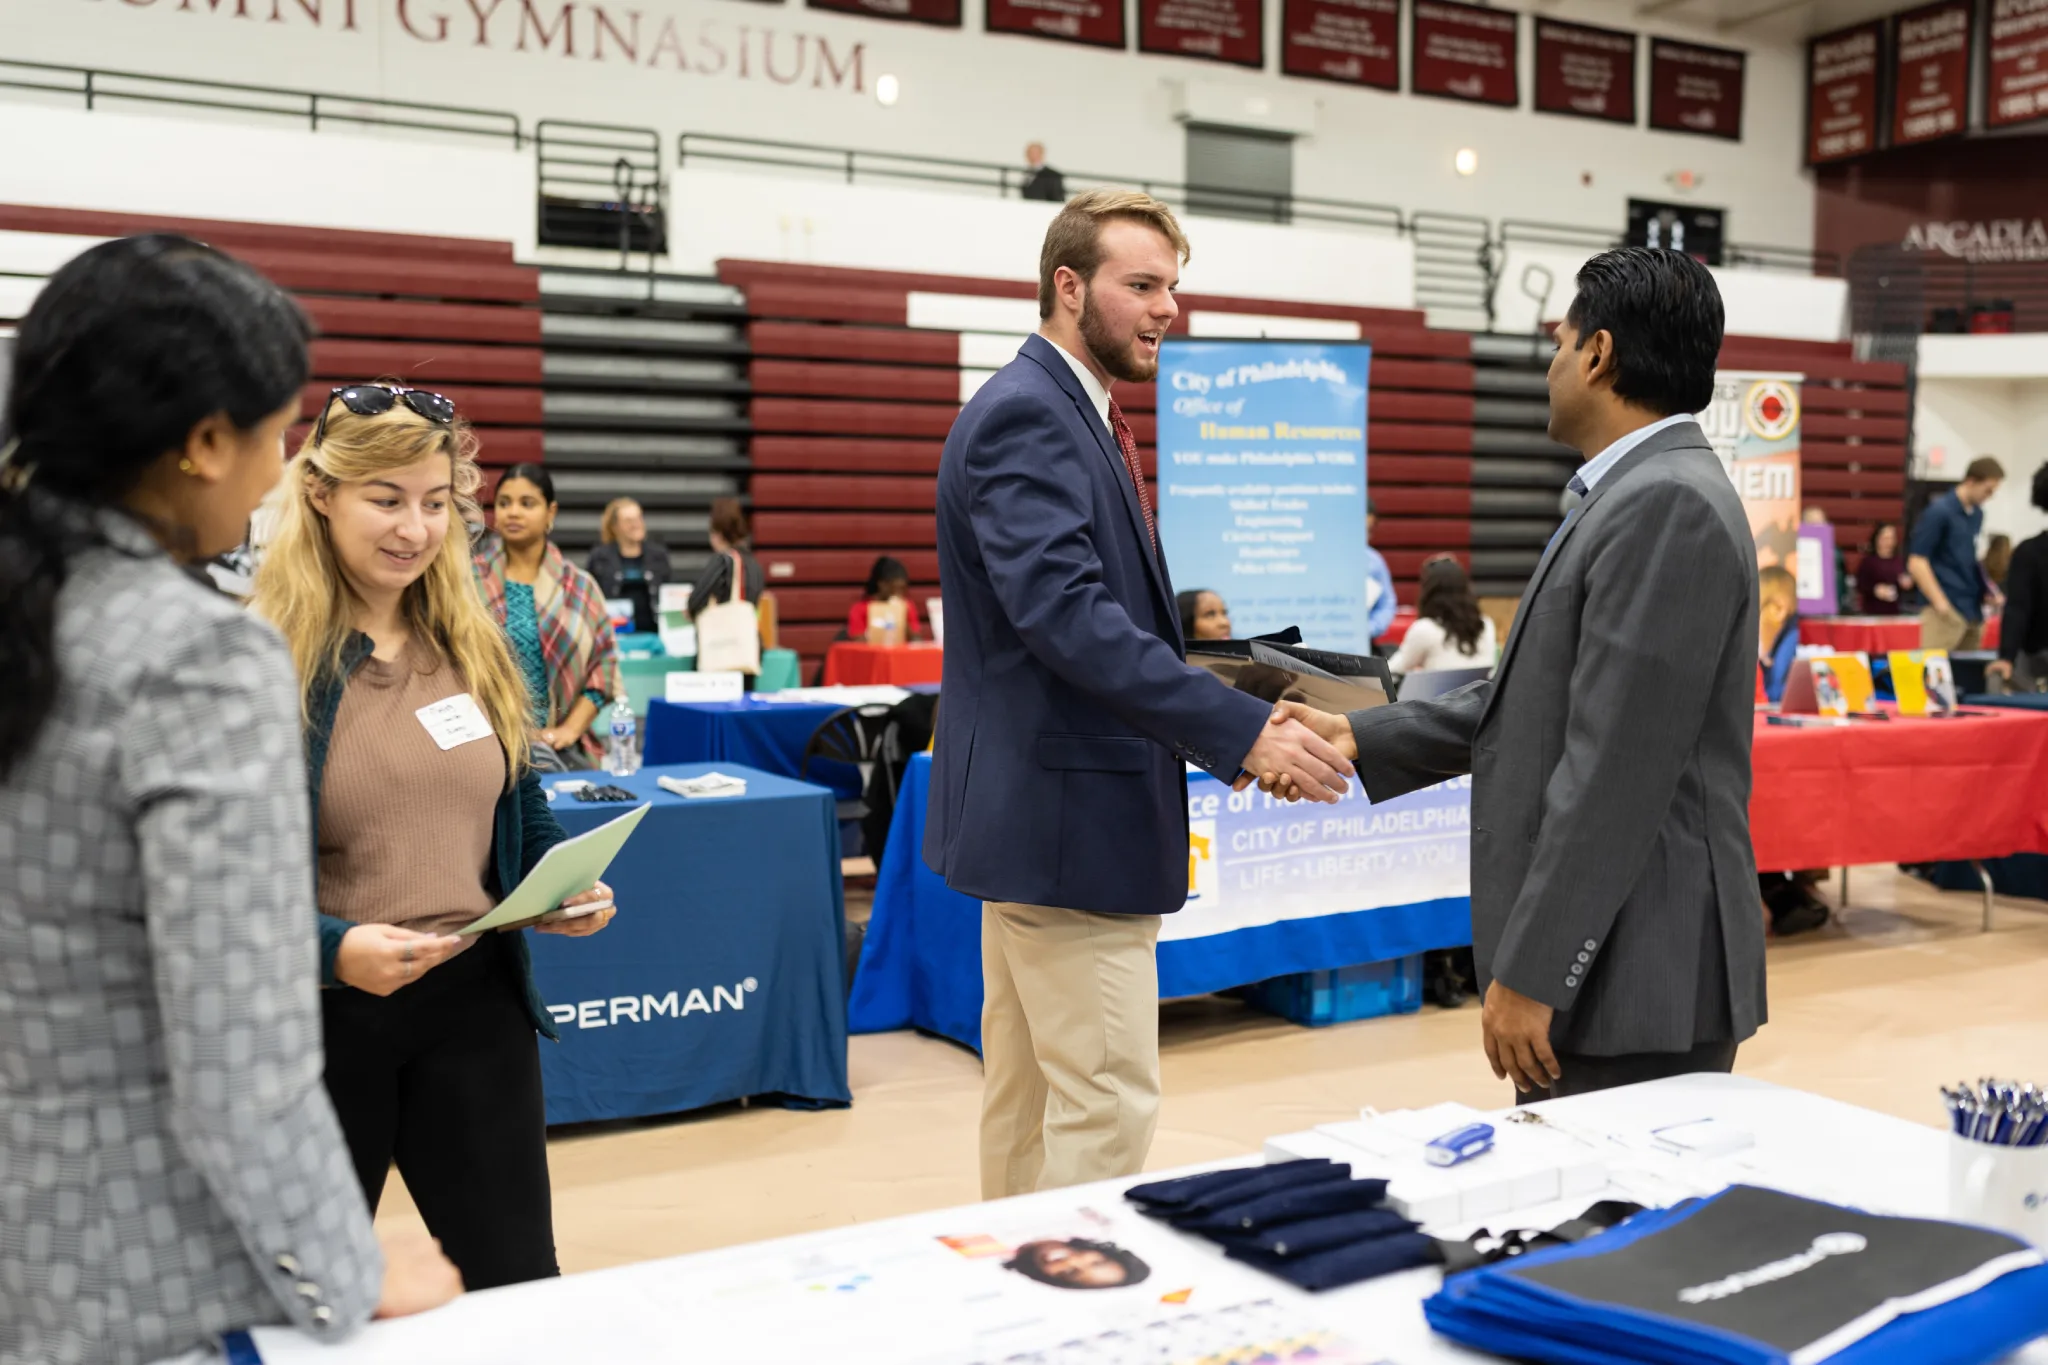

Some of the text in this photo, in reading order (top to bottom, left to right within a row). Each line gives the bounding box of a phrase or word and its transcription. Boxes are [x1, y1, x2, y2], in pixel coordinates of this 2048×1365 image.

[395, 0, 868, 94] GYMNASIUM
[1901, 218, 2047, 257] ARCADIA
[1172, 359, 1346, 394] City of Philadelphia
[1172, 396, 1246, 417] Office of
[1201, 422, 1362, 441] Human Resources
[1231, 806, 1470, 852] CITY OF PHILADELPHIA
[1240, 843, 1457, 890] LIFE LIBERTY YOU
